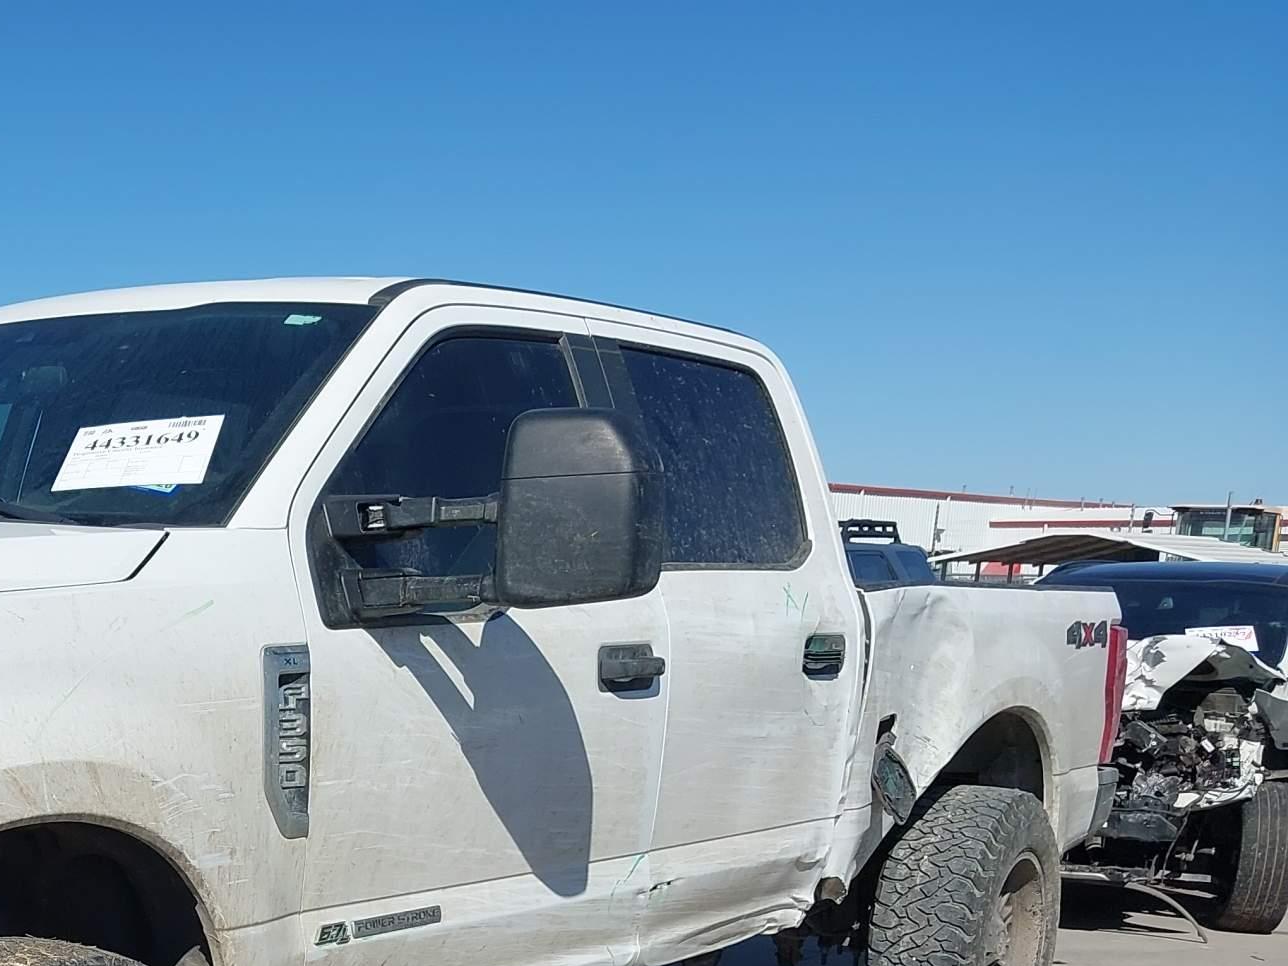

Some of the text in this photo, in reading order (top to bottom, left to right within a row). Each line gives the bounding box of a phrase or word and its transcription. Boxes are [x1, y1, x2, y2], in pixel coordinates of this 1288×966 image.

[85, 430, 200, 451] 44331649
[284, 657, 298, 666] XL
[357, 915, 395, 933] POWER
